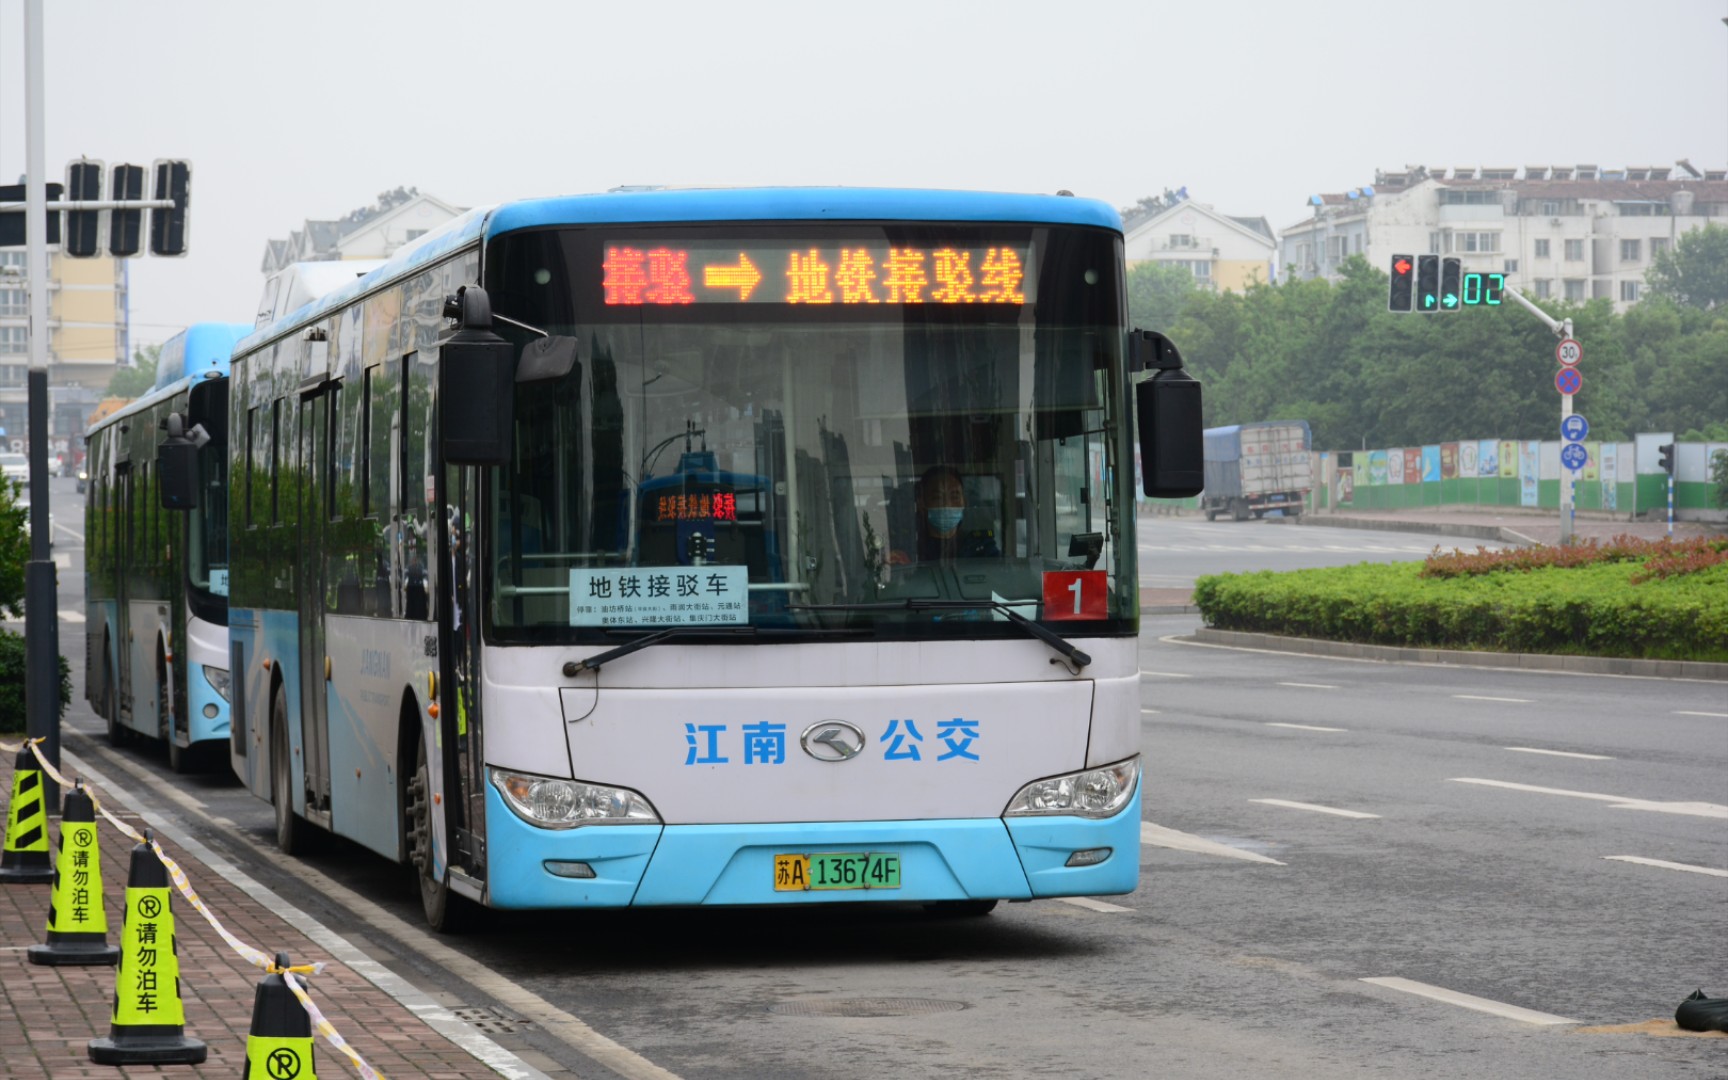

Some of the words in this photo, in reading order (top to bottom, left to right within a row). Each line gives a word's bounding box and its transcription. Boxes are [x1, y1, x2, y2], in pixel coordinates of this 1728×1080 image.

[785, 246, 1025, 305] 地铁接驳线
[1463, 273, 1504, 305] 02
[1561, 346, 1575, 359] 30
[589, 573, 728, 599] 地铁接驳车
[1067, 577, 1082, 615] 1
[684, 721, 786, 766] 江南
[879, 718, 980, 762] 公交
[71, 850, 89, 924] 请勿泊车
[136, 922, 158, 1015] 请勿泊车
